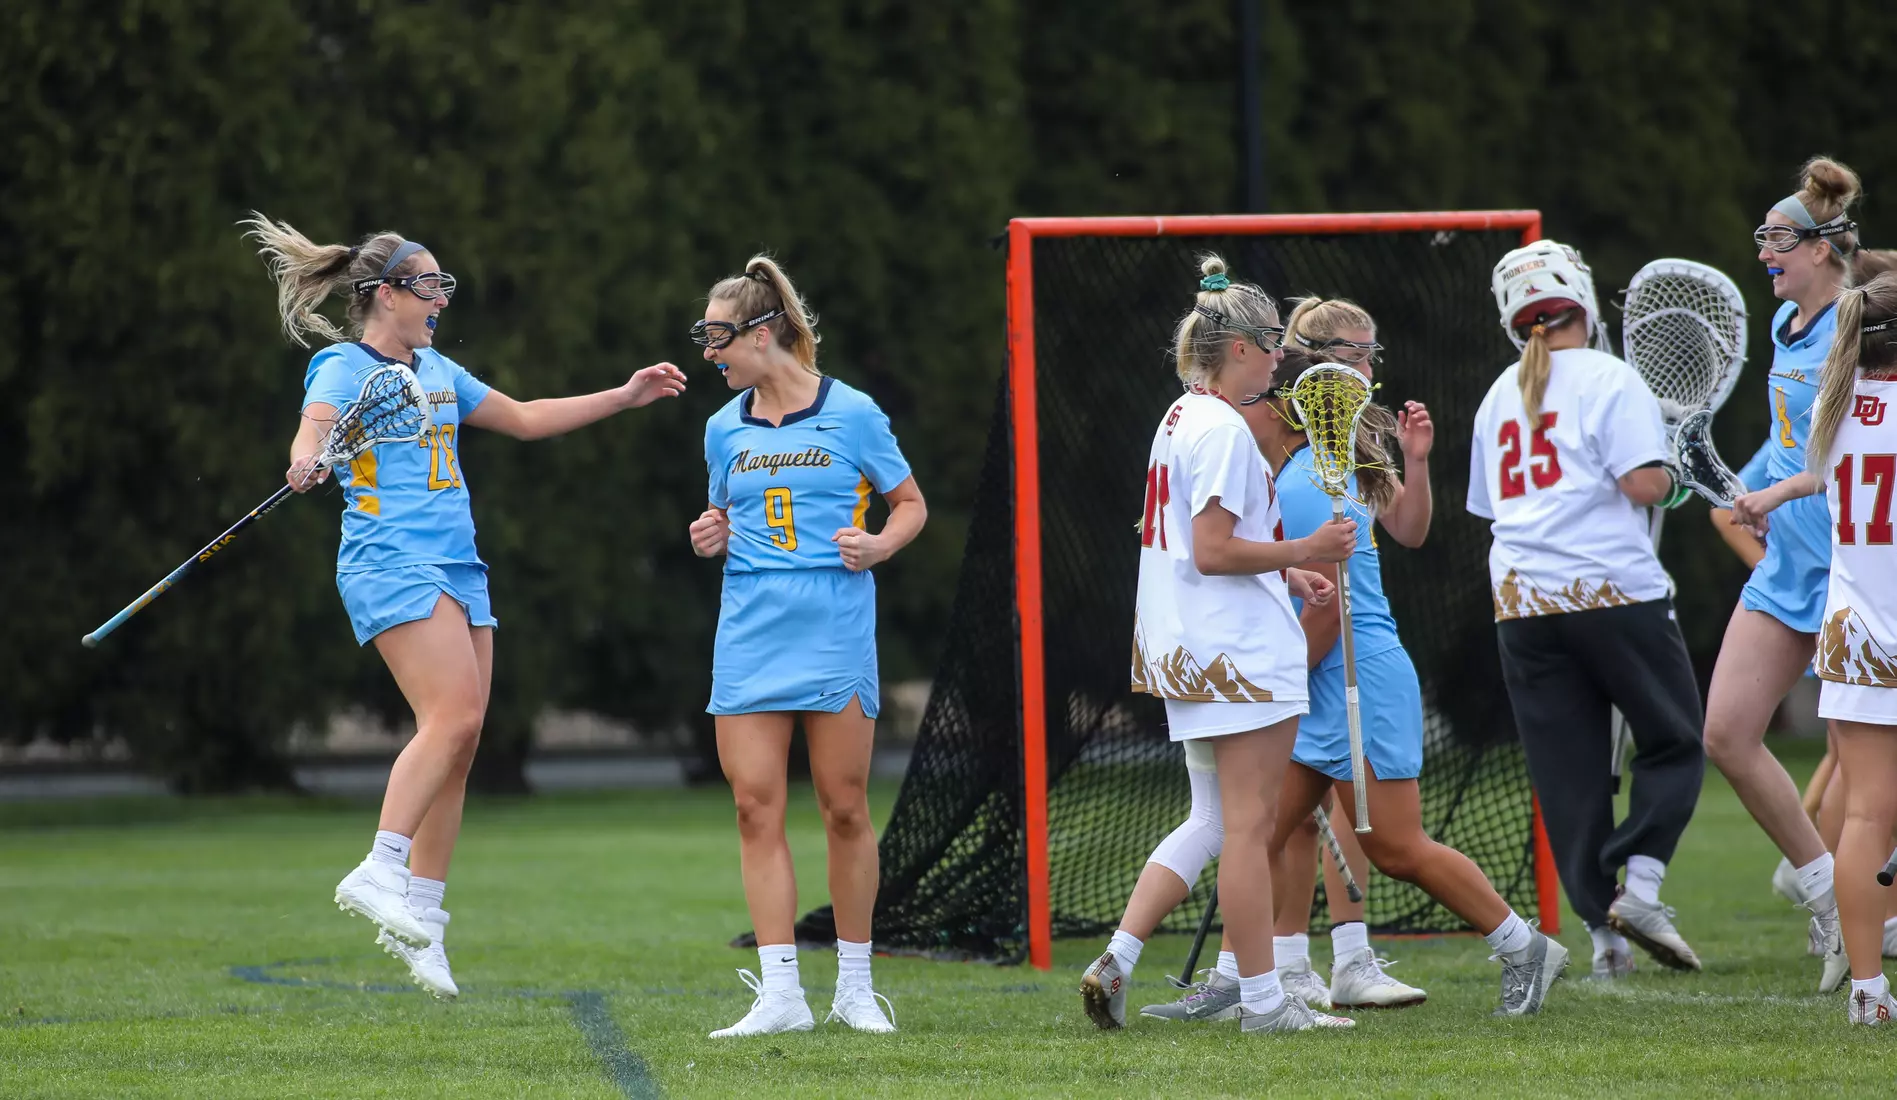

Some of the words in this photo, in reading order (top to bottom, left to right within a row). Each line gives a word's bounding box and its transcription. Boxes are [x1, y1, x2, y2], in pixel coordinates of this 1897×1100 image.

[1819, 226, 1844, 236] BRINE
[358, 279, 385, 289] BRINE
[1502, 259, 1547, 281] PIONEERS
[748, 310, 775, 327] BRINE
[1851, 395, 1887, 426] DU
[731, 447, 832, 476] Marquette
[1498, 411, 1563, 501] 25
[1834, 454, 1897, 545] 17
[763, 486, 798, 552] 9
